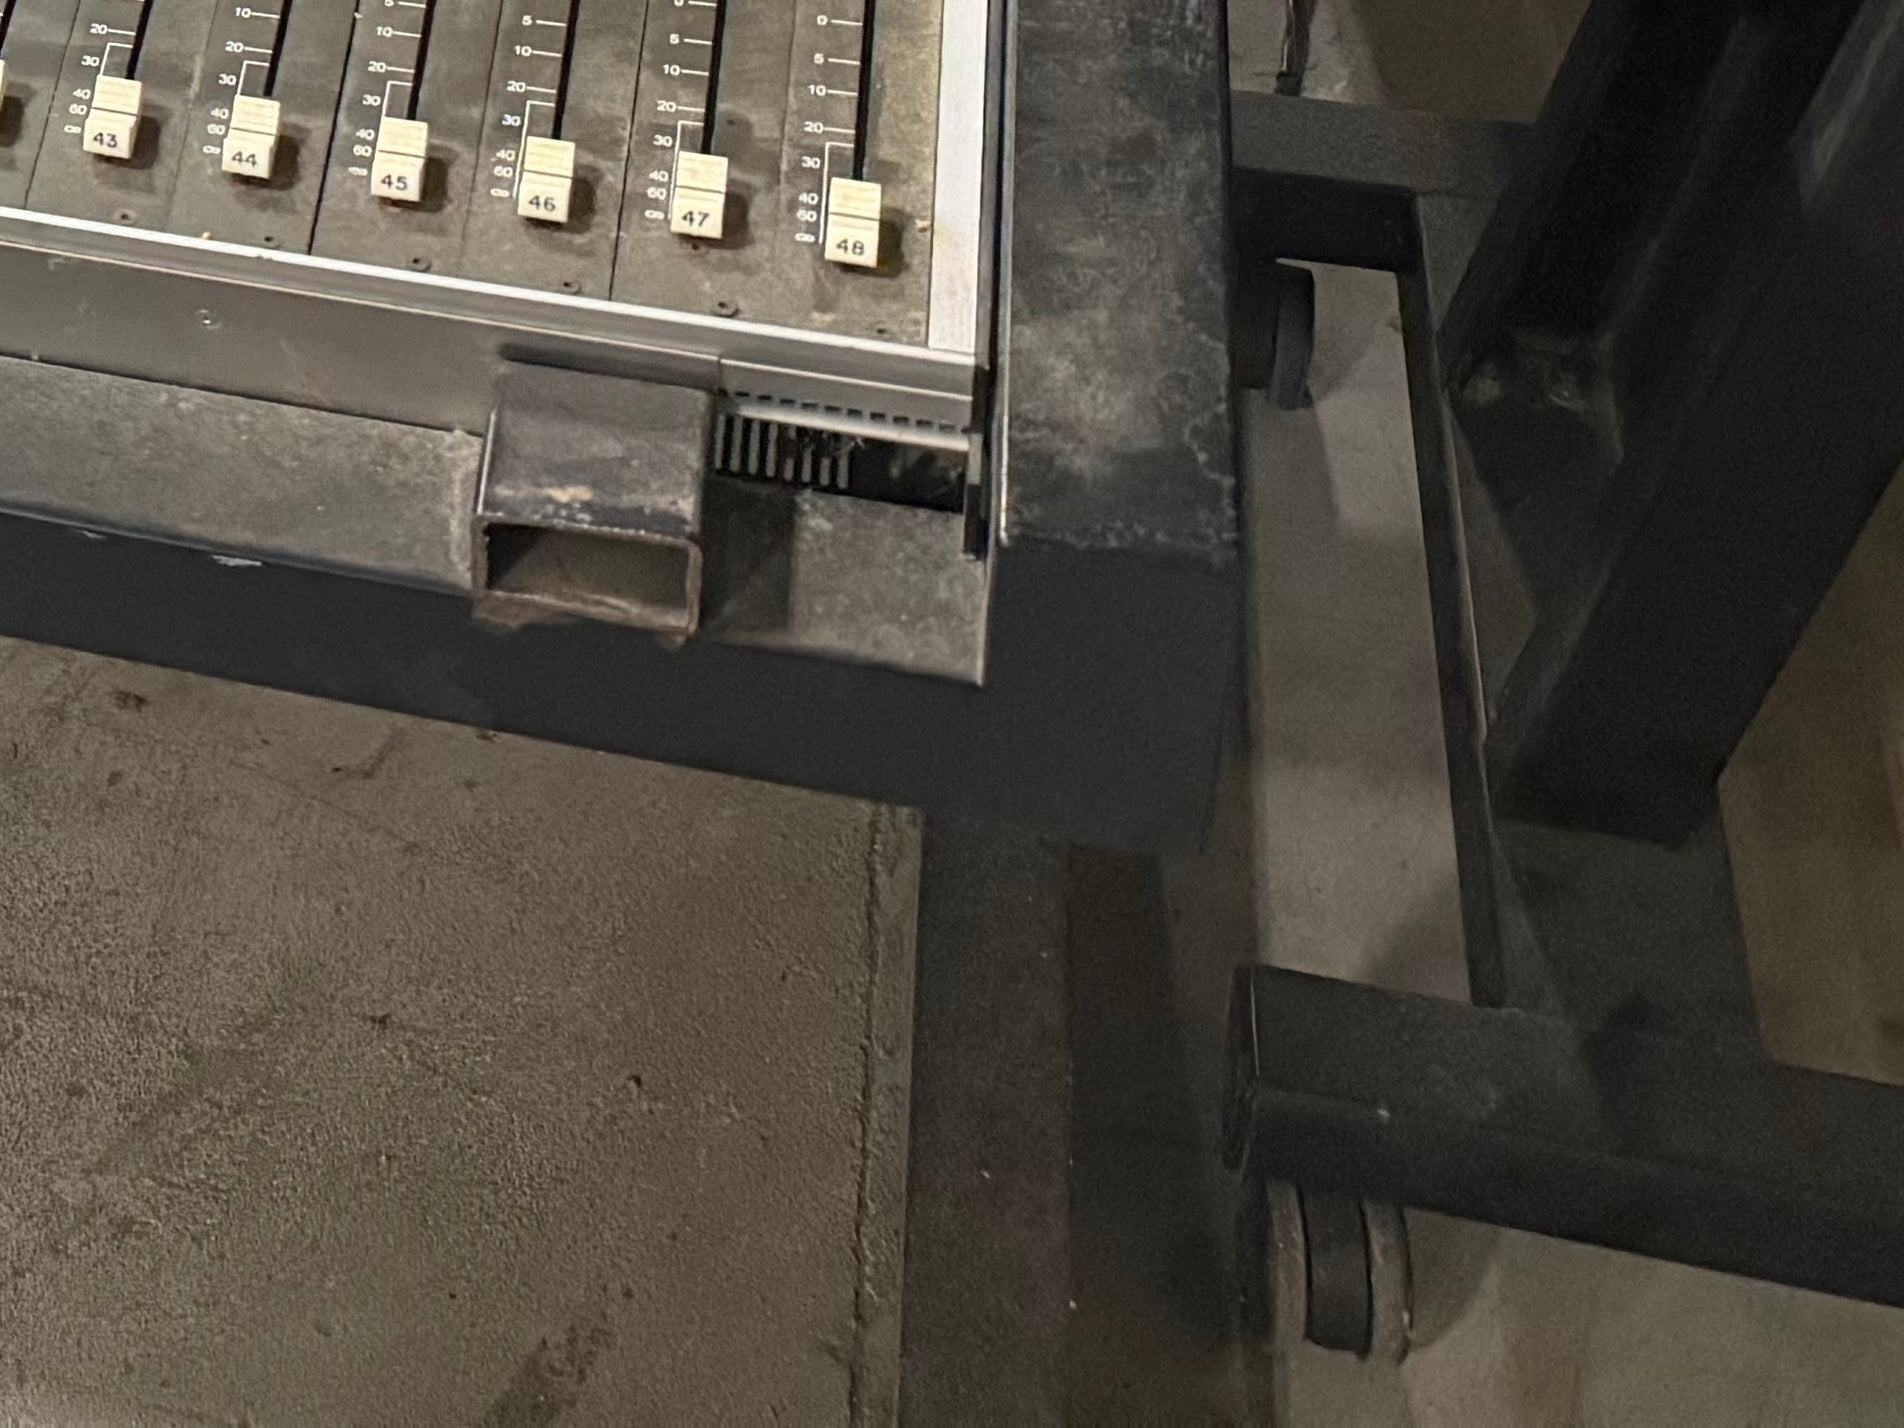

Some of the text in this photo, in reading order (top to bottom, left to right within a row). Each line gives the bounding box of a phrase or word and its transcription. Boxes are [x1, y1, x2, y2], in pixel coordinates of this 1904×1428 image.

[522, 15, 532, 25] 5
[817, 15, 828, 25] 0
[90, 24, 108, 34] 20
[376, 27, 393, 37] 10
[670, 34, 680, 44] 5
[514, 46, 532, 56] 10
[814, 54, 824, 64] 5
[368, 62, 387, 72] 20
[663, 65, 681, 75] 10
[506, 81, 526, 92] 20
[808, 85, 827, 96] 10
[362, 95, 381, 106] 30
[657, 101, 677, 112] 20
[502, 115, 521, 126] 30
[804, 122, 824, 133] 20
[93, 131, 118, 149] 43
[653, 135, 673, 147] 30
[231, 149, 259, 167] 44
[802, 157, 821, 168] 30
[380, 173, 408, 191] 45
[528, 194, 556, 212] 46
[681, 209, 709, 227] 47
[836, 238, 865, 255] 48
